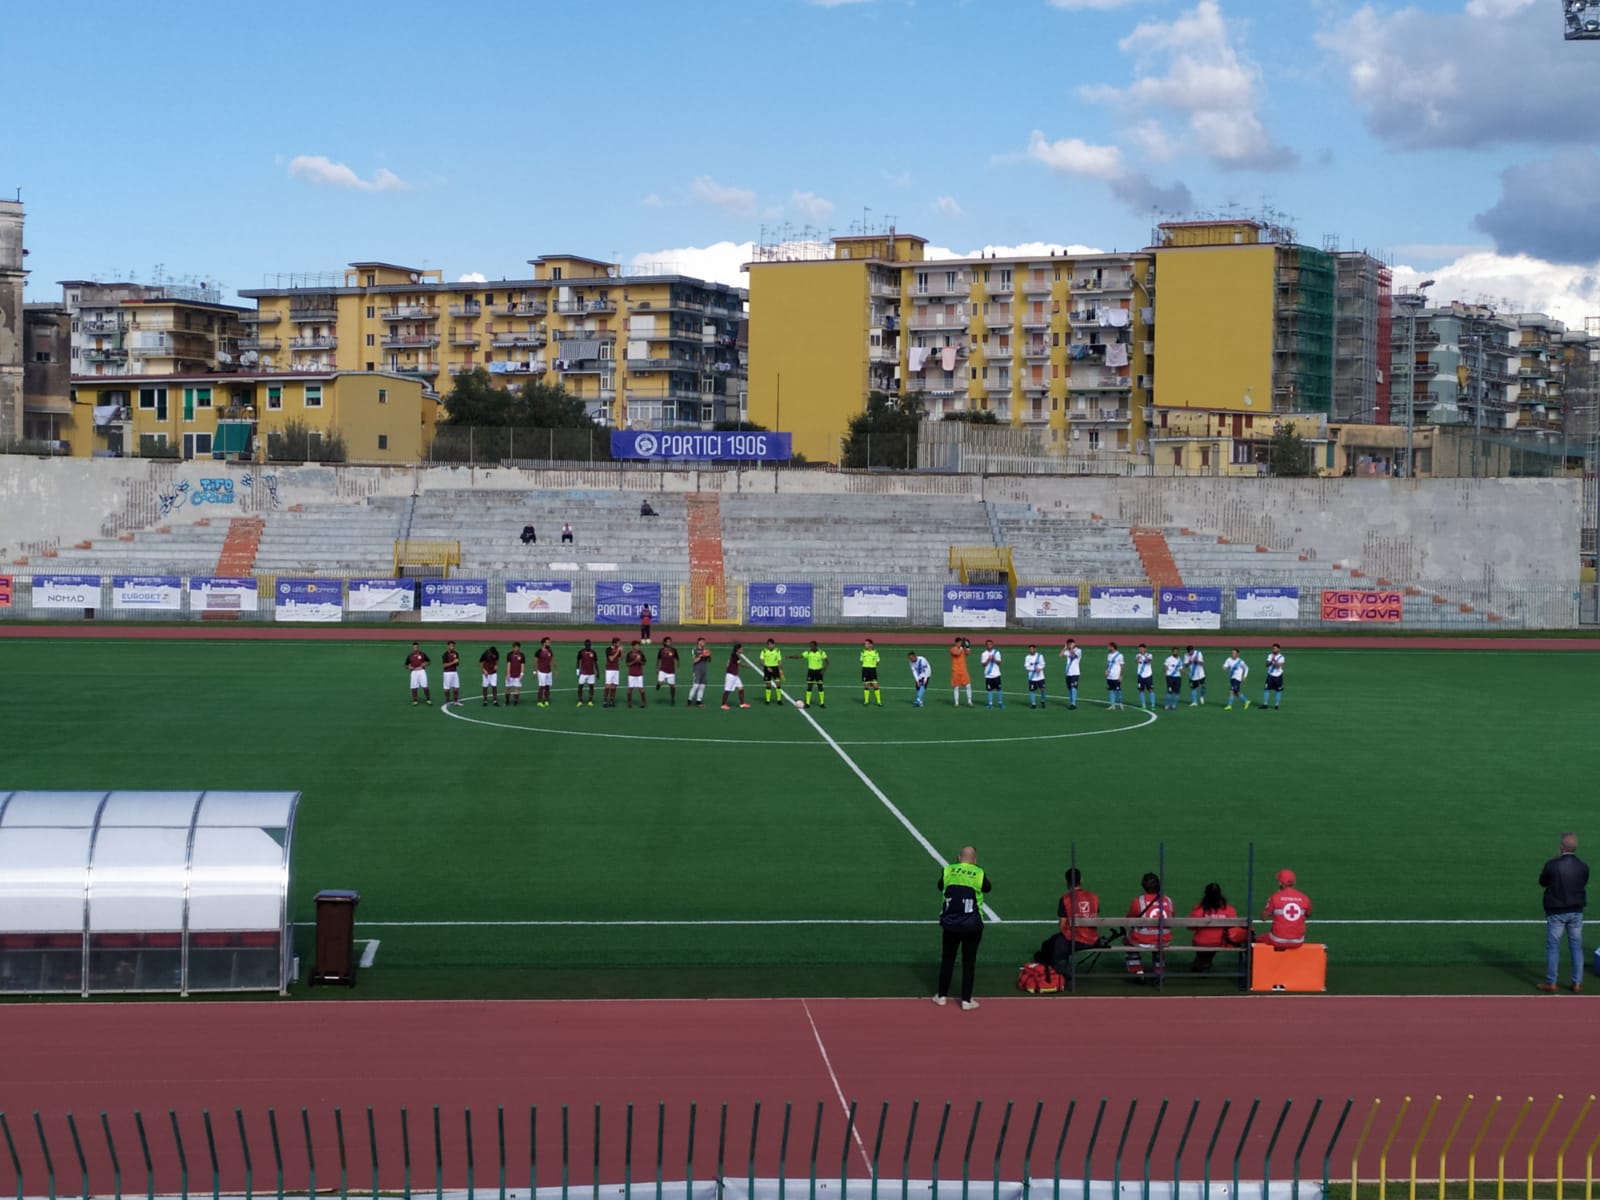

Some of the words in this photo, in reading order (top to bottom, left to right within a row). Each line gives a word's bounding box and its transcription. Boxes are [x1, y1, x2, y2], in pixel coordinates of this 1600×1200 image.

[661, 435, 721, 455] PORTICI
[727, 435, 767, 455] 1906
[437, 584, 464, 594] PORTICI
[465, 584, 483, 595] 1906
[958, 590, 984, 601] PORTICI
[986, 590, 1003, 601] 1906
[1337, 594, 1400, 604] GIVOVA
[597, 604, 632, 616] PORTICI
[751, 605, 786, 617] PORTICI
[789, 606, 811, 618] 1906
[1337, 608, 1400, 619] GIVOVA
